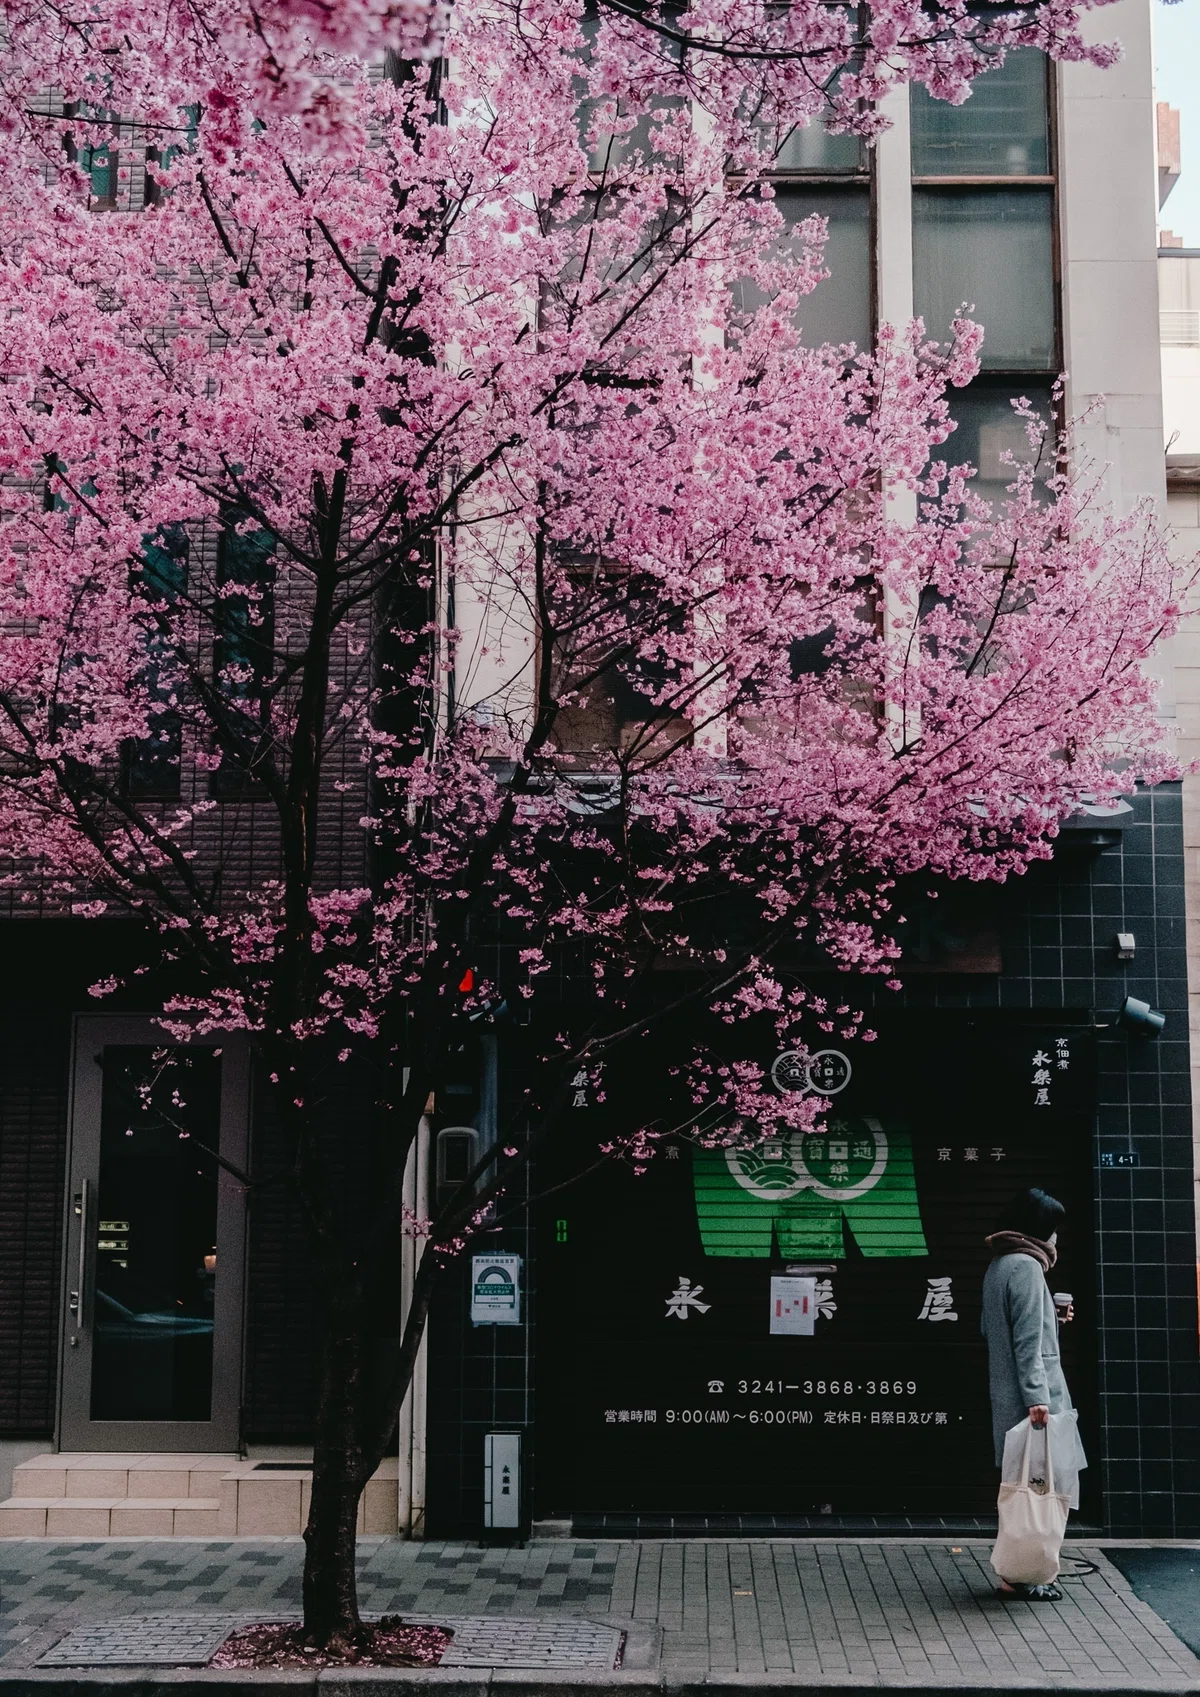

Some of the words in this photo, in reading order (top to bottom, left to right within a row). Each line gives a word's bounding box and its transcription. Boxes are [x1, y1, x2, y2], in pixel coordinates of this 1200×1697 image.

[936, 1147, 1007, 1162] 京菓子
[1118, 1155, 1134, 1164] 4-1
[604, 1409, 657, 1423] 営業時間
